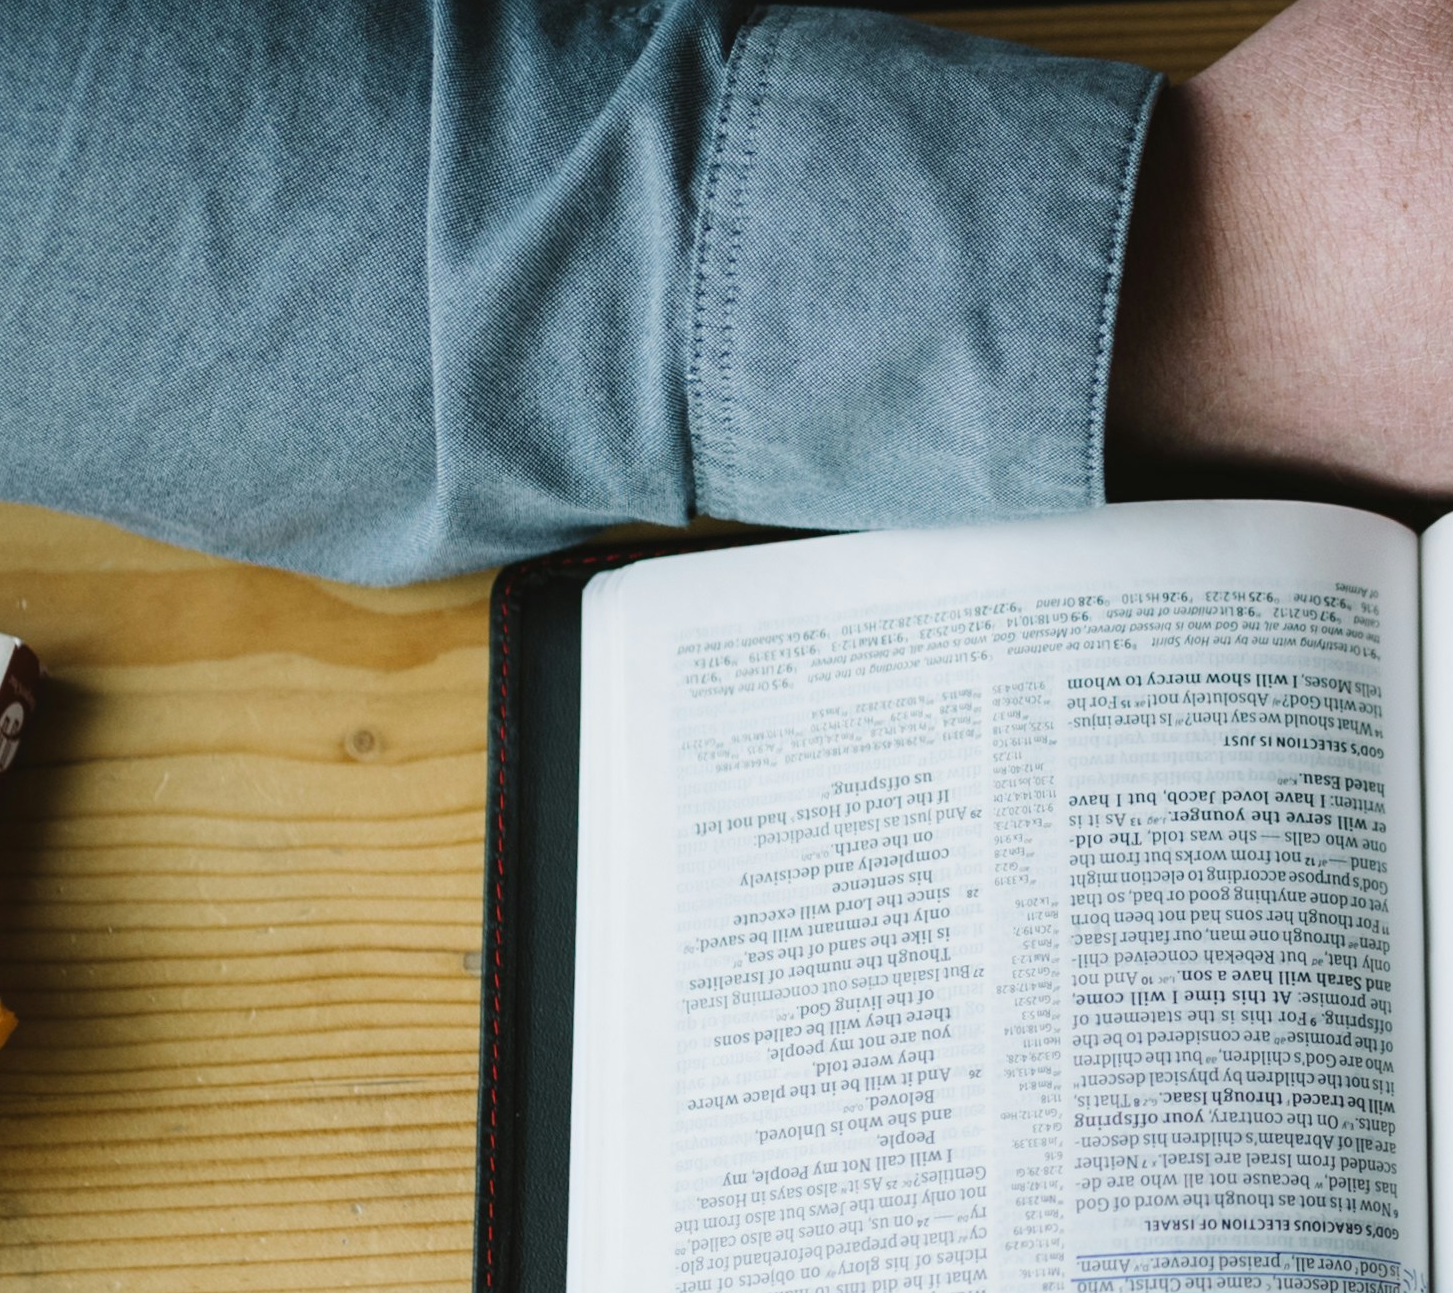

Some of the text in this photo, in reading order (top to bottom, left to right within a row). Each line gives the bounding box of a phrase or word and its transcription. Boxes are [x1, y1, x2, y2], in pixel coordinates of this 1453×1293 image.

[1224, 735, 1385, 760] GOD'S SELECTION IS JUST
[740, 848, 950, 889] completely and decisively
[714, 1007, 952, 1048] there they will be called sons
[767, 1025, 953, 1063] you are not my people,
[812, 1049, 935, 1078] they were told,
[755, 1108, 953, 1146] and she who is Unloved,
[877, 1130, 936, 1150] People,
[1144, 1218, 1400, 1239] GOD'S GRACIOUS ELECTION OF ISRAEL
